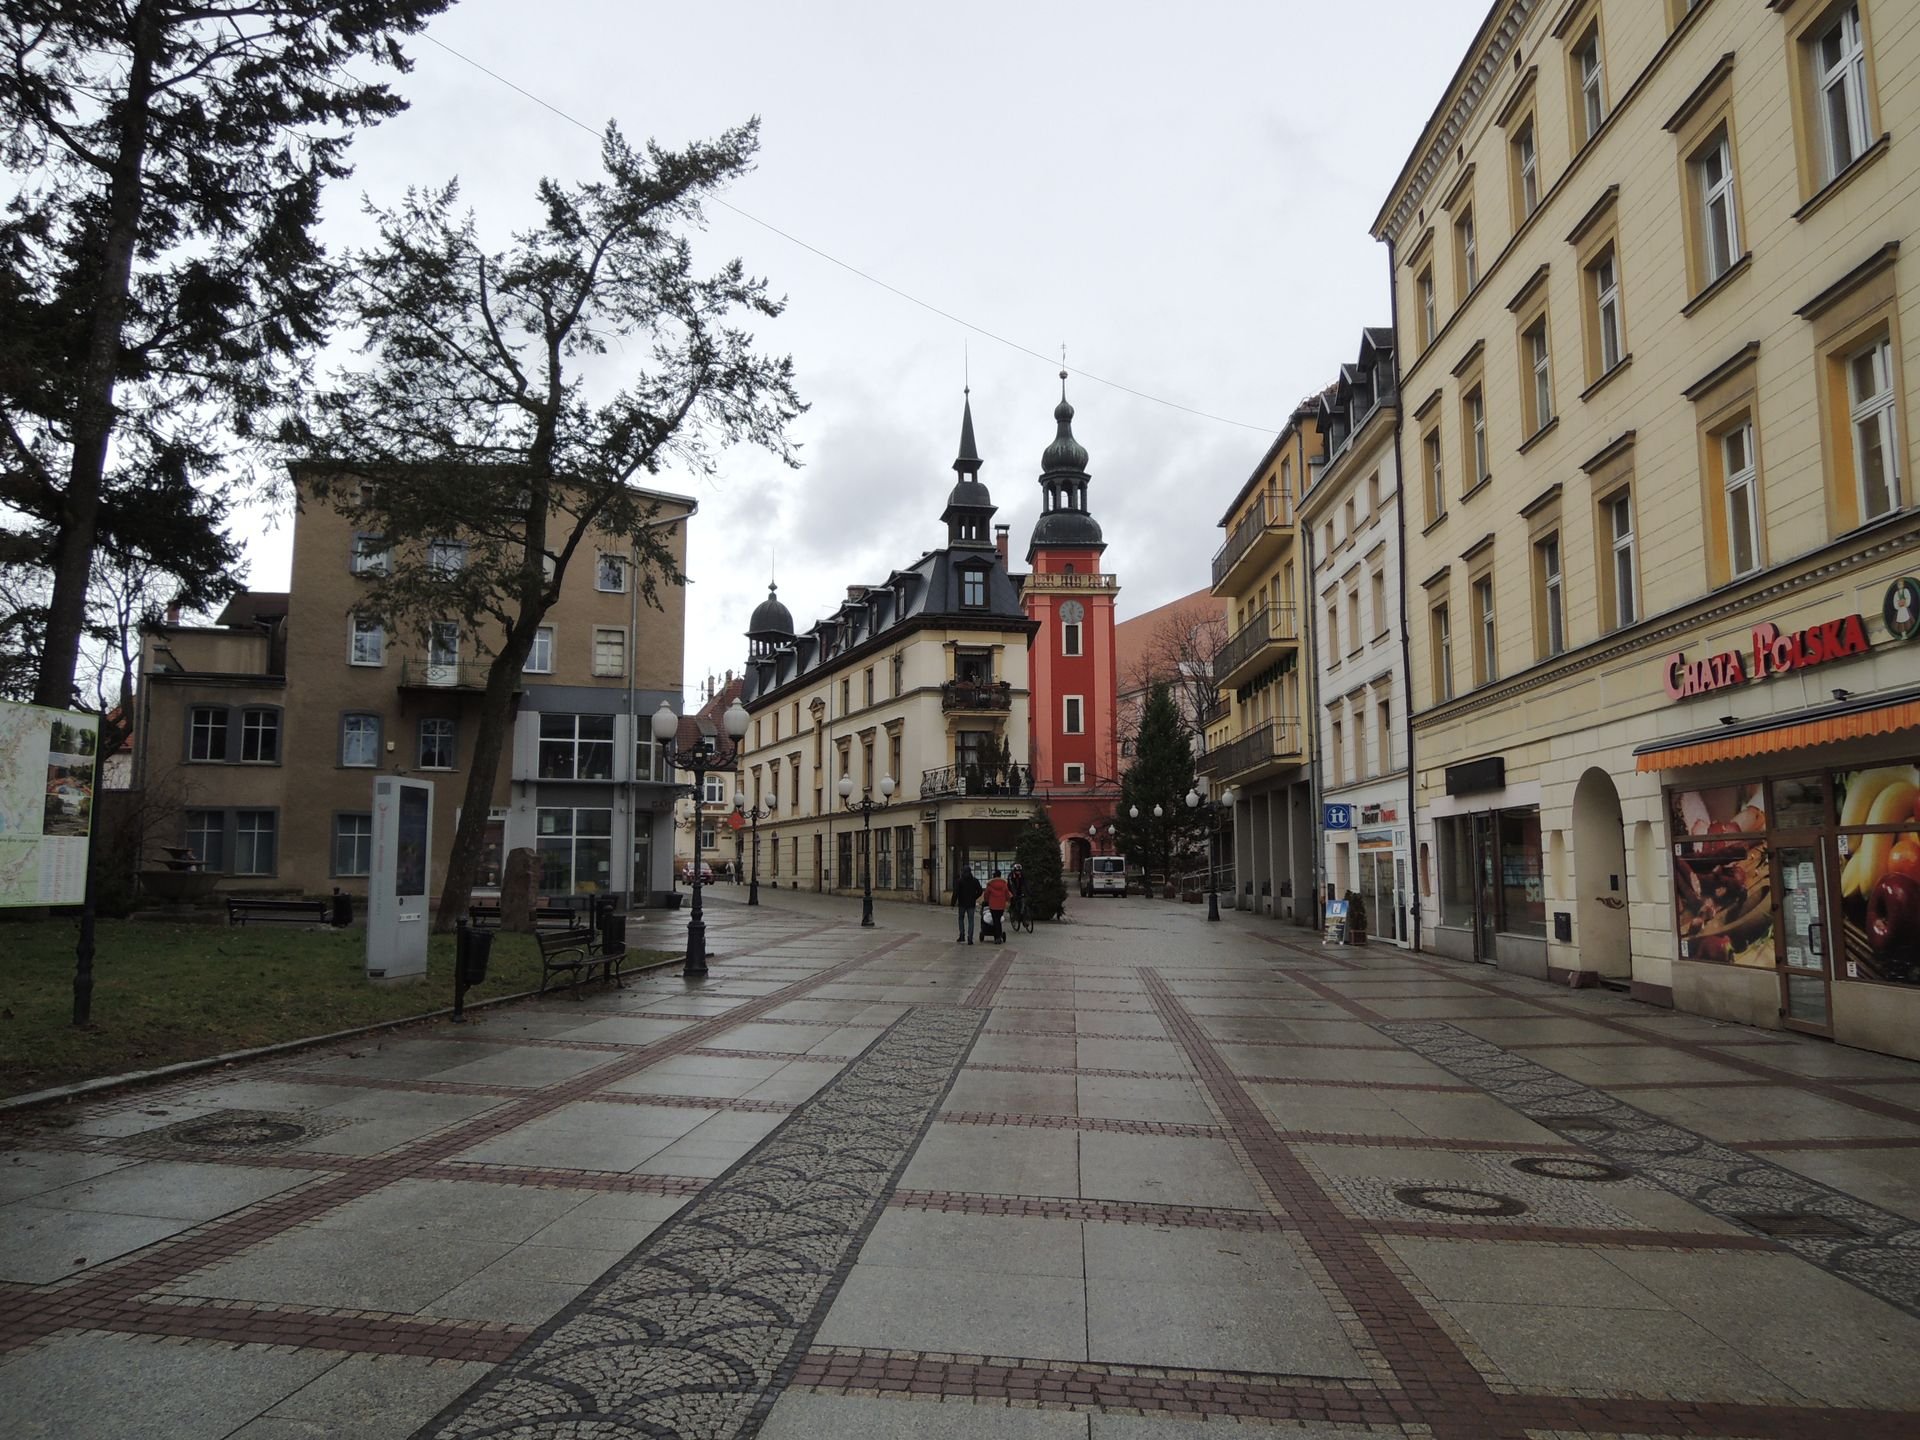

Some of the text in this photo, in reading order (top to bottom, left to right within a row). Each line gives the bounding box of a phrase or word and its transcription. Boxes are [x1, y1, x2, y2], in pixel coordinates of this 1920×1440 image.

[1663, 614, 1871, 699] CHATA POLSKA
[1330, 808, 1347, 824] it
